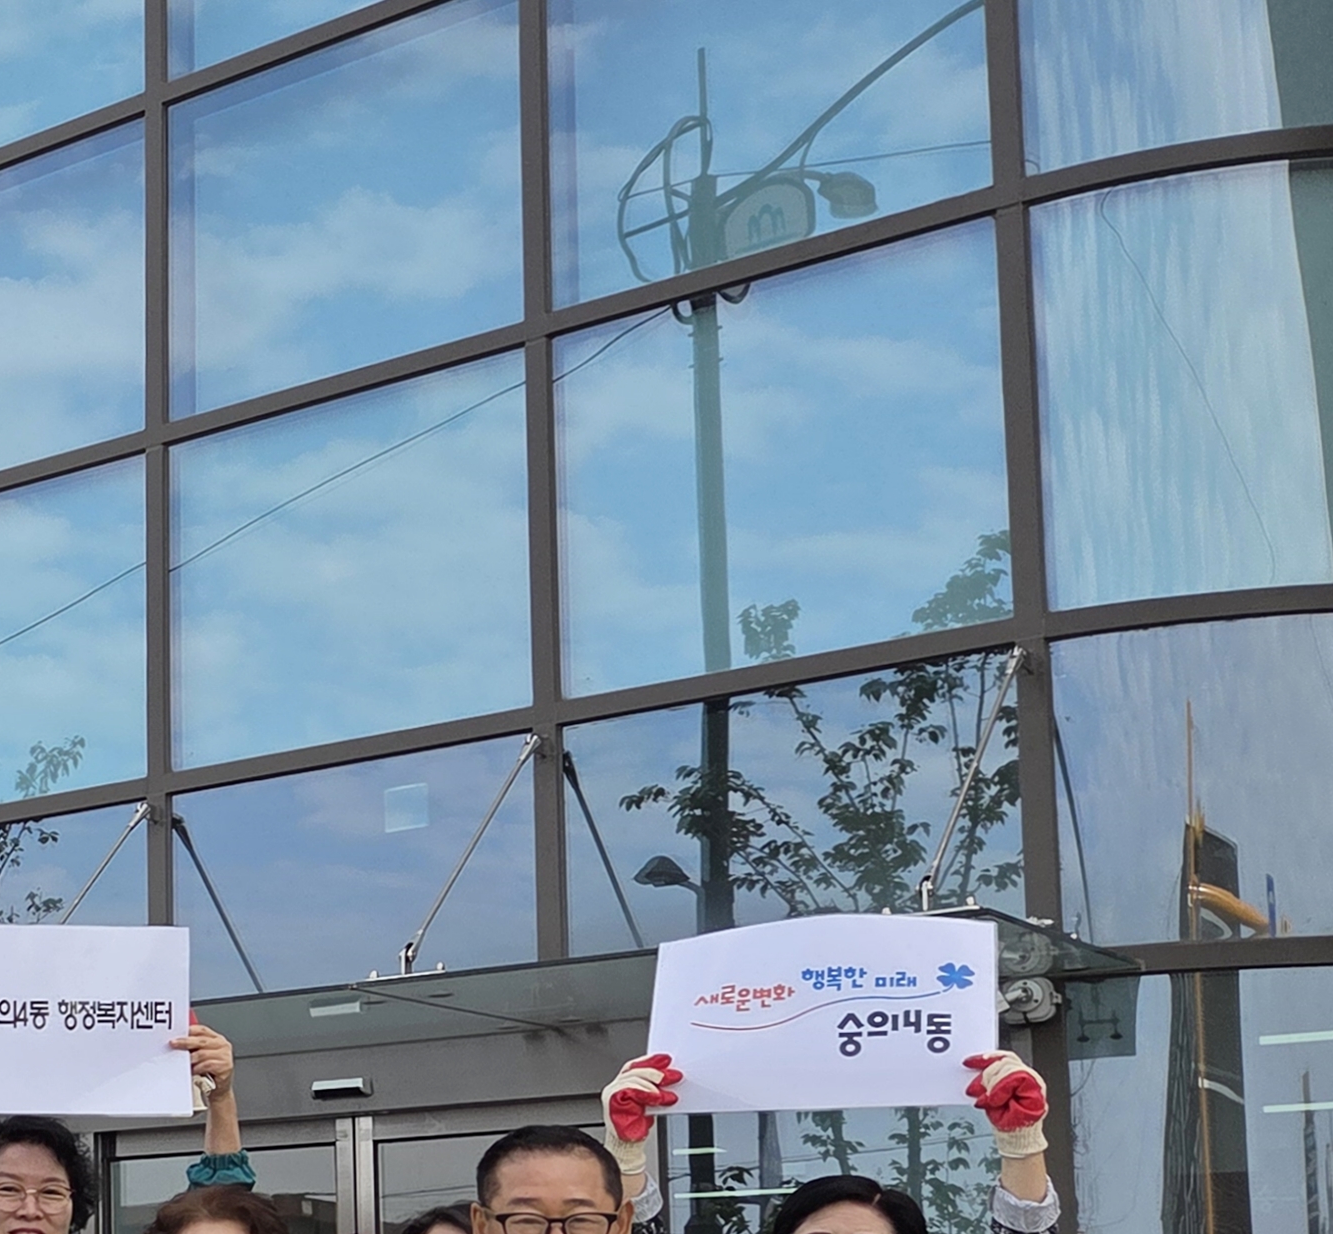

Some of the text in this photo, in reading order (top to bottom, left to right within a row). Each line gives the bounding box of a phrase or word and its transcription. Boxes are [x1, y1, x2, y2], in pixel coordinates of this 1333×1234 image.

[694, 964, 917, 1012] 새로운변화 행복한 미래
[57, 998, 173, 1032] 행정복지센터
[836, 1009, 953, 1057] 숭의4동
